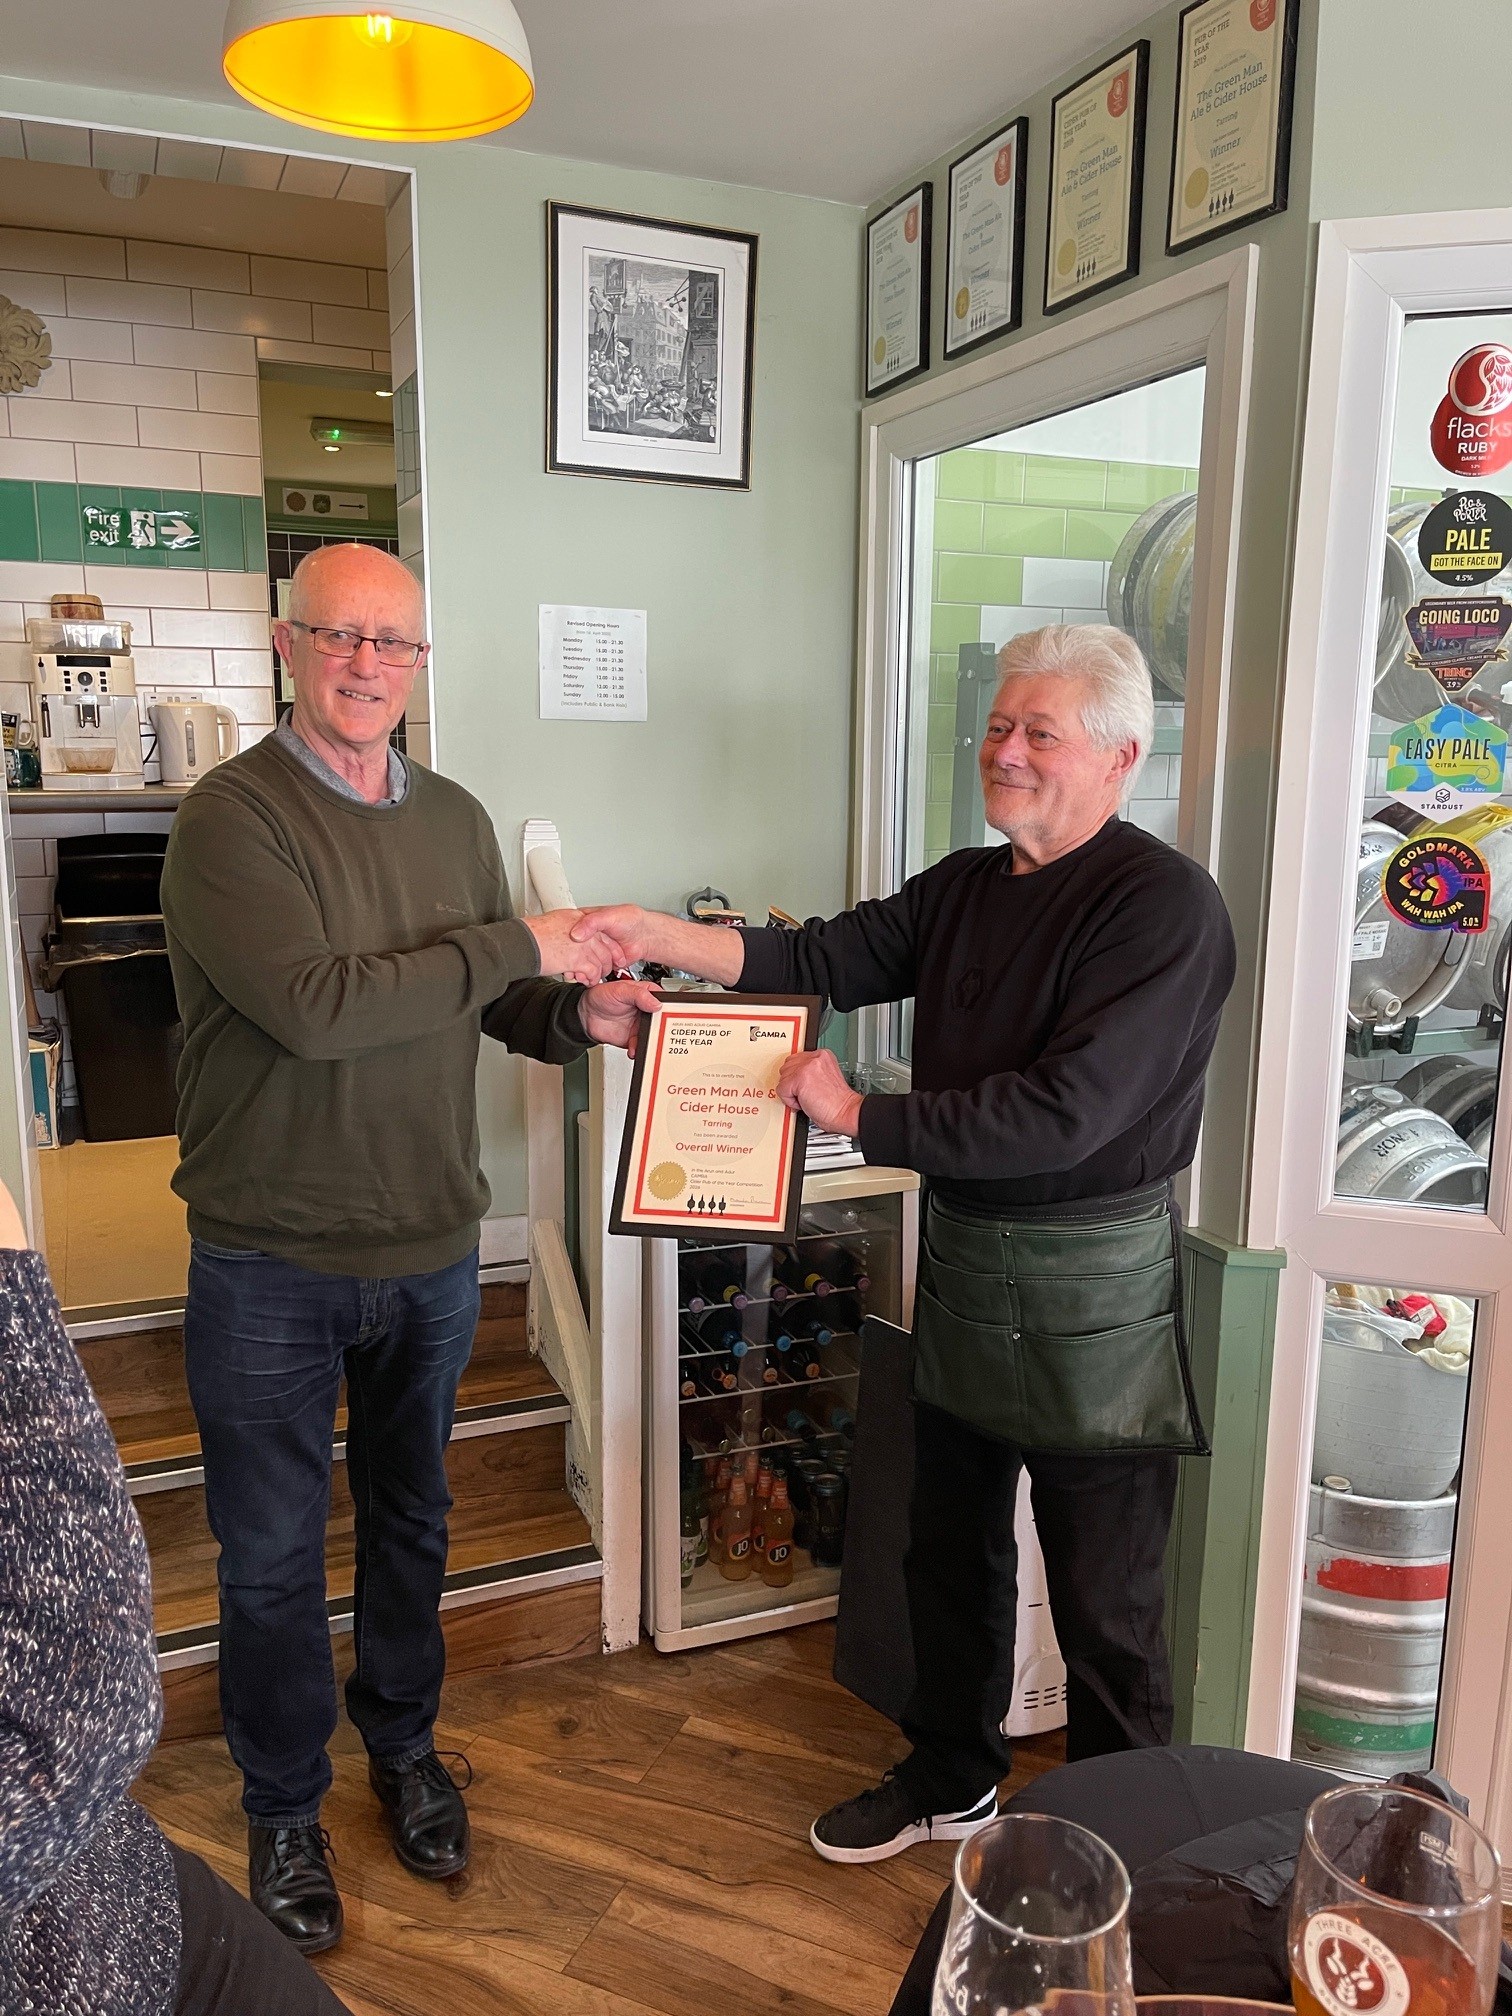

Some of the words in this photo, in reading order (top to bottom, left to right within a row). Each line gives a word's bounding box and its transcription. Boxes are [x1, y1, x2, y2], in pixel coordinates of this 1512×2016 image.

[1194, 33, 1207, 46] PUB
[1207, 28, 1216, 38] OF
[1217, 19, 1230, 32] THE
[1193, 43, 1210, 57] YEAR
[1196, 89, 1213, 104] The
[1214, 74, 1241, 93] Green
[1242, 62, 1263, 79] Man
[1190, 107, 1204, 121] Ale
[1213, 90, 1237, 108] Cider
[1239, 74, 1267, 95] House
[1210, 137, 1241, 159] Winner
[1080, 155, 1100, 172] Green
[1102, 145, 1118, 160] Man
[1080, 169, 1098, 185] Cider
[1100, 155, 1122, 174] House
[1447, 416, 1512, 439] flacks
[1457, 441, 1498, 454] RUBY
[86, 511, 120, 526] Fire
[89, 529, 120, 543] exit
[1446, 529, 1492, 551] PALE
[1434, 557, 1450, 567] GOT
[1451, 557, 1466, 566] THE
[1467, 556, 1485, 566] FACE
[1488, 556, 1499, 566] ON
[1419, 609, 1460, 625] GOING
[1464, 608, 1500, 624] LOCO
[1405, 738, 1446, 760] EASY
[1452, 738, 1491, 760] PALE
[1398, 842, 1475, 871] GOLDMARK
[1464, 877, 1484, 888] IPA
[1400, 898, 1422, 917] WAH
[1423, 909, 1447, 919] WAH
[1448, 901, 1465, 915] IPA
[699, 1029, 717, 1037] PUB
[754, 1030, 787, 1038] CAMRA
[668, 1047, 689, 1055] 2026
[667, 1084, 706, 1096] Green
[710, 1086, 739, 1097] Man
[741, 1087, 764, 1099] Ale
[767, 1089, 777, 1099] &
[679, 1101, 715, 1113] Cider
[717, 1103, 759, 1115] House
[702, 1119, 733, 1129] Tarring
[675, 1142, 714, 1152] Overall
[716, 1144, 754, 1154] Winner
[1316, 1920, 1352, 1935] THREE
